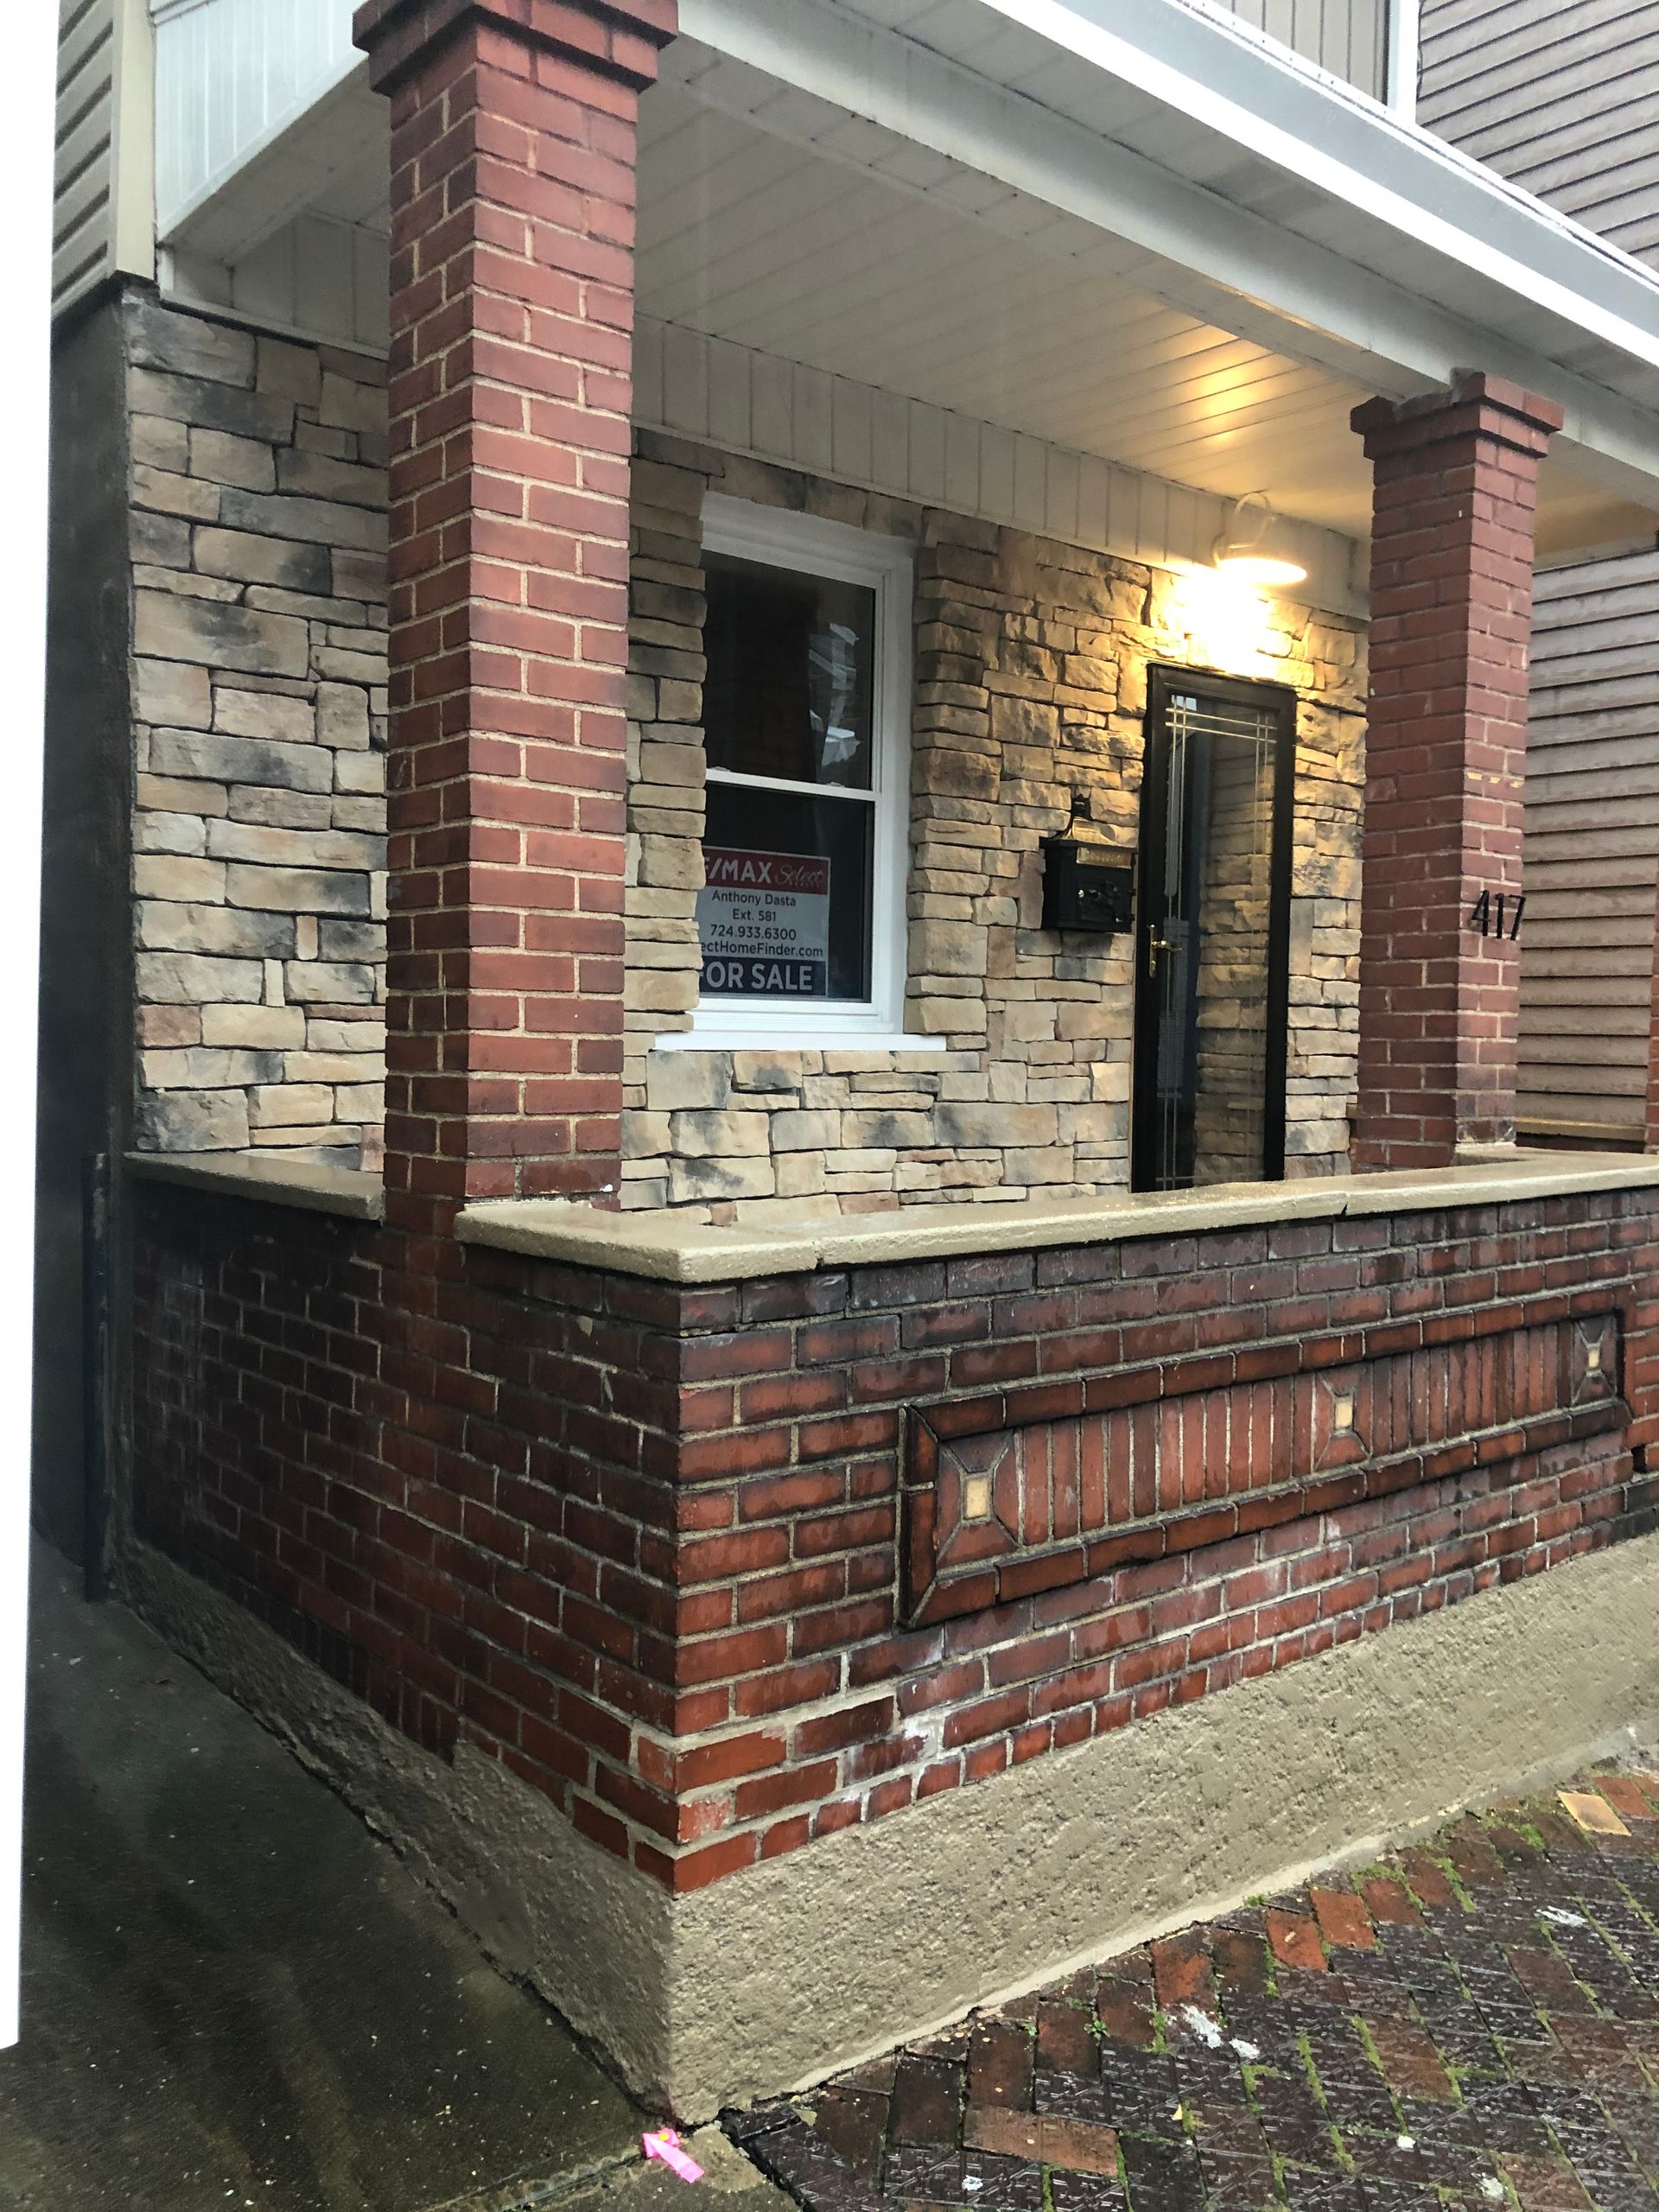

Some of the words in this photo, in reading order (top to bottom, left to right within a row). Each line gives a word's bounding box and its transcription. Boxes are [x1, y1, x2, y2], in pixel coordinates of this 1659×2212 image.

[774, 864, 824, 886] Select
[712, 890, 761, 906] Anthony
[765, 893, 797, 907] Dasta
[733, 908, 754, 921] Ext.
[759, 910, 777, 922] 581
[1471, 889, 1527, 941] 417
[710, 924, 797, 941] 724.933.6300
[751, 963, 812, 990] SALE
